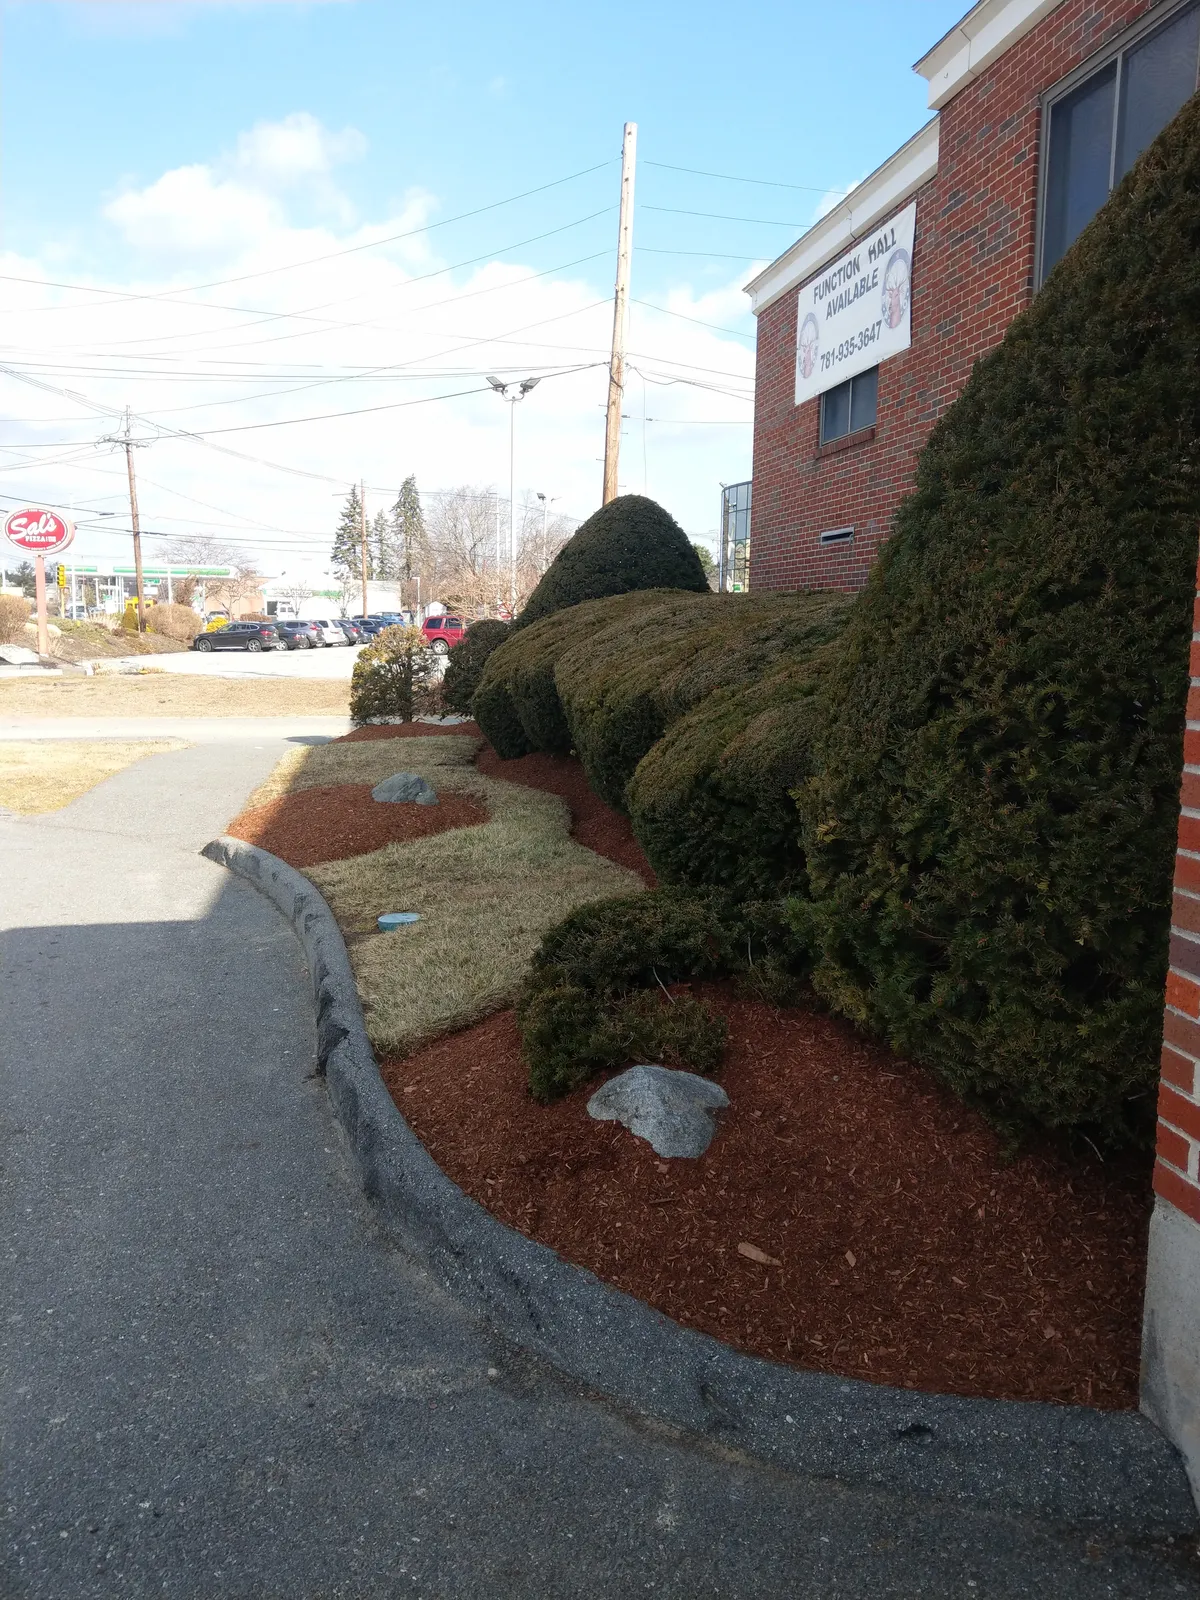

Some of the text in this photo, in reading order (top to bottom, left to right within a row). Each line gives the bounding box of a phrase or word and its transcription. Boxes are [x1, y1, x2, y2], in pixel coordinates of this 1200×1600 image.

[813, 227, 897, 305] FUNCTION HALL
[826, 267, 879, 320] AVAILABLE
[820, 320, 882, 372] 781-935-3647
[9, 512, 57, 540] Sal's
